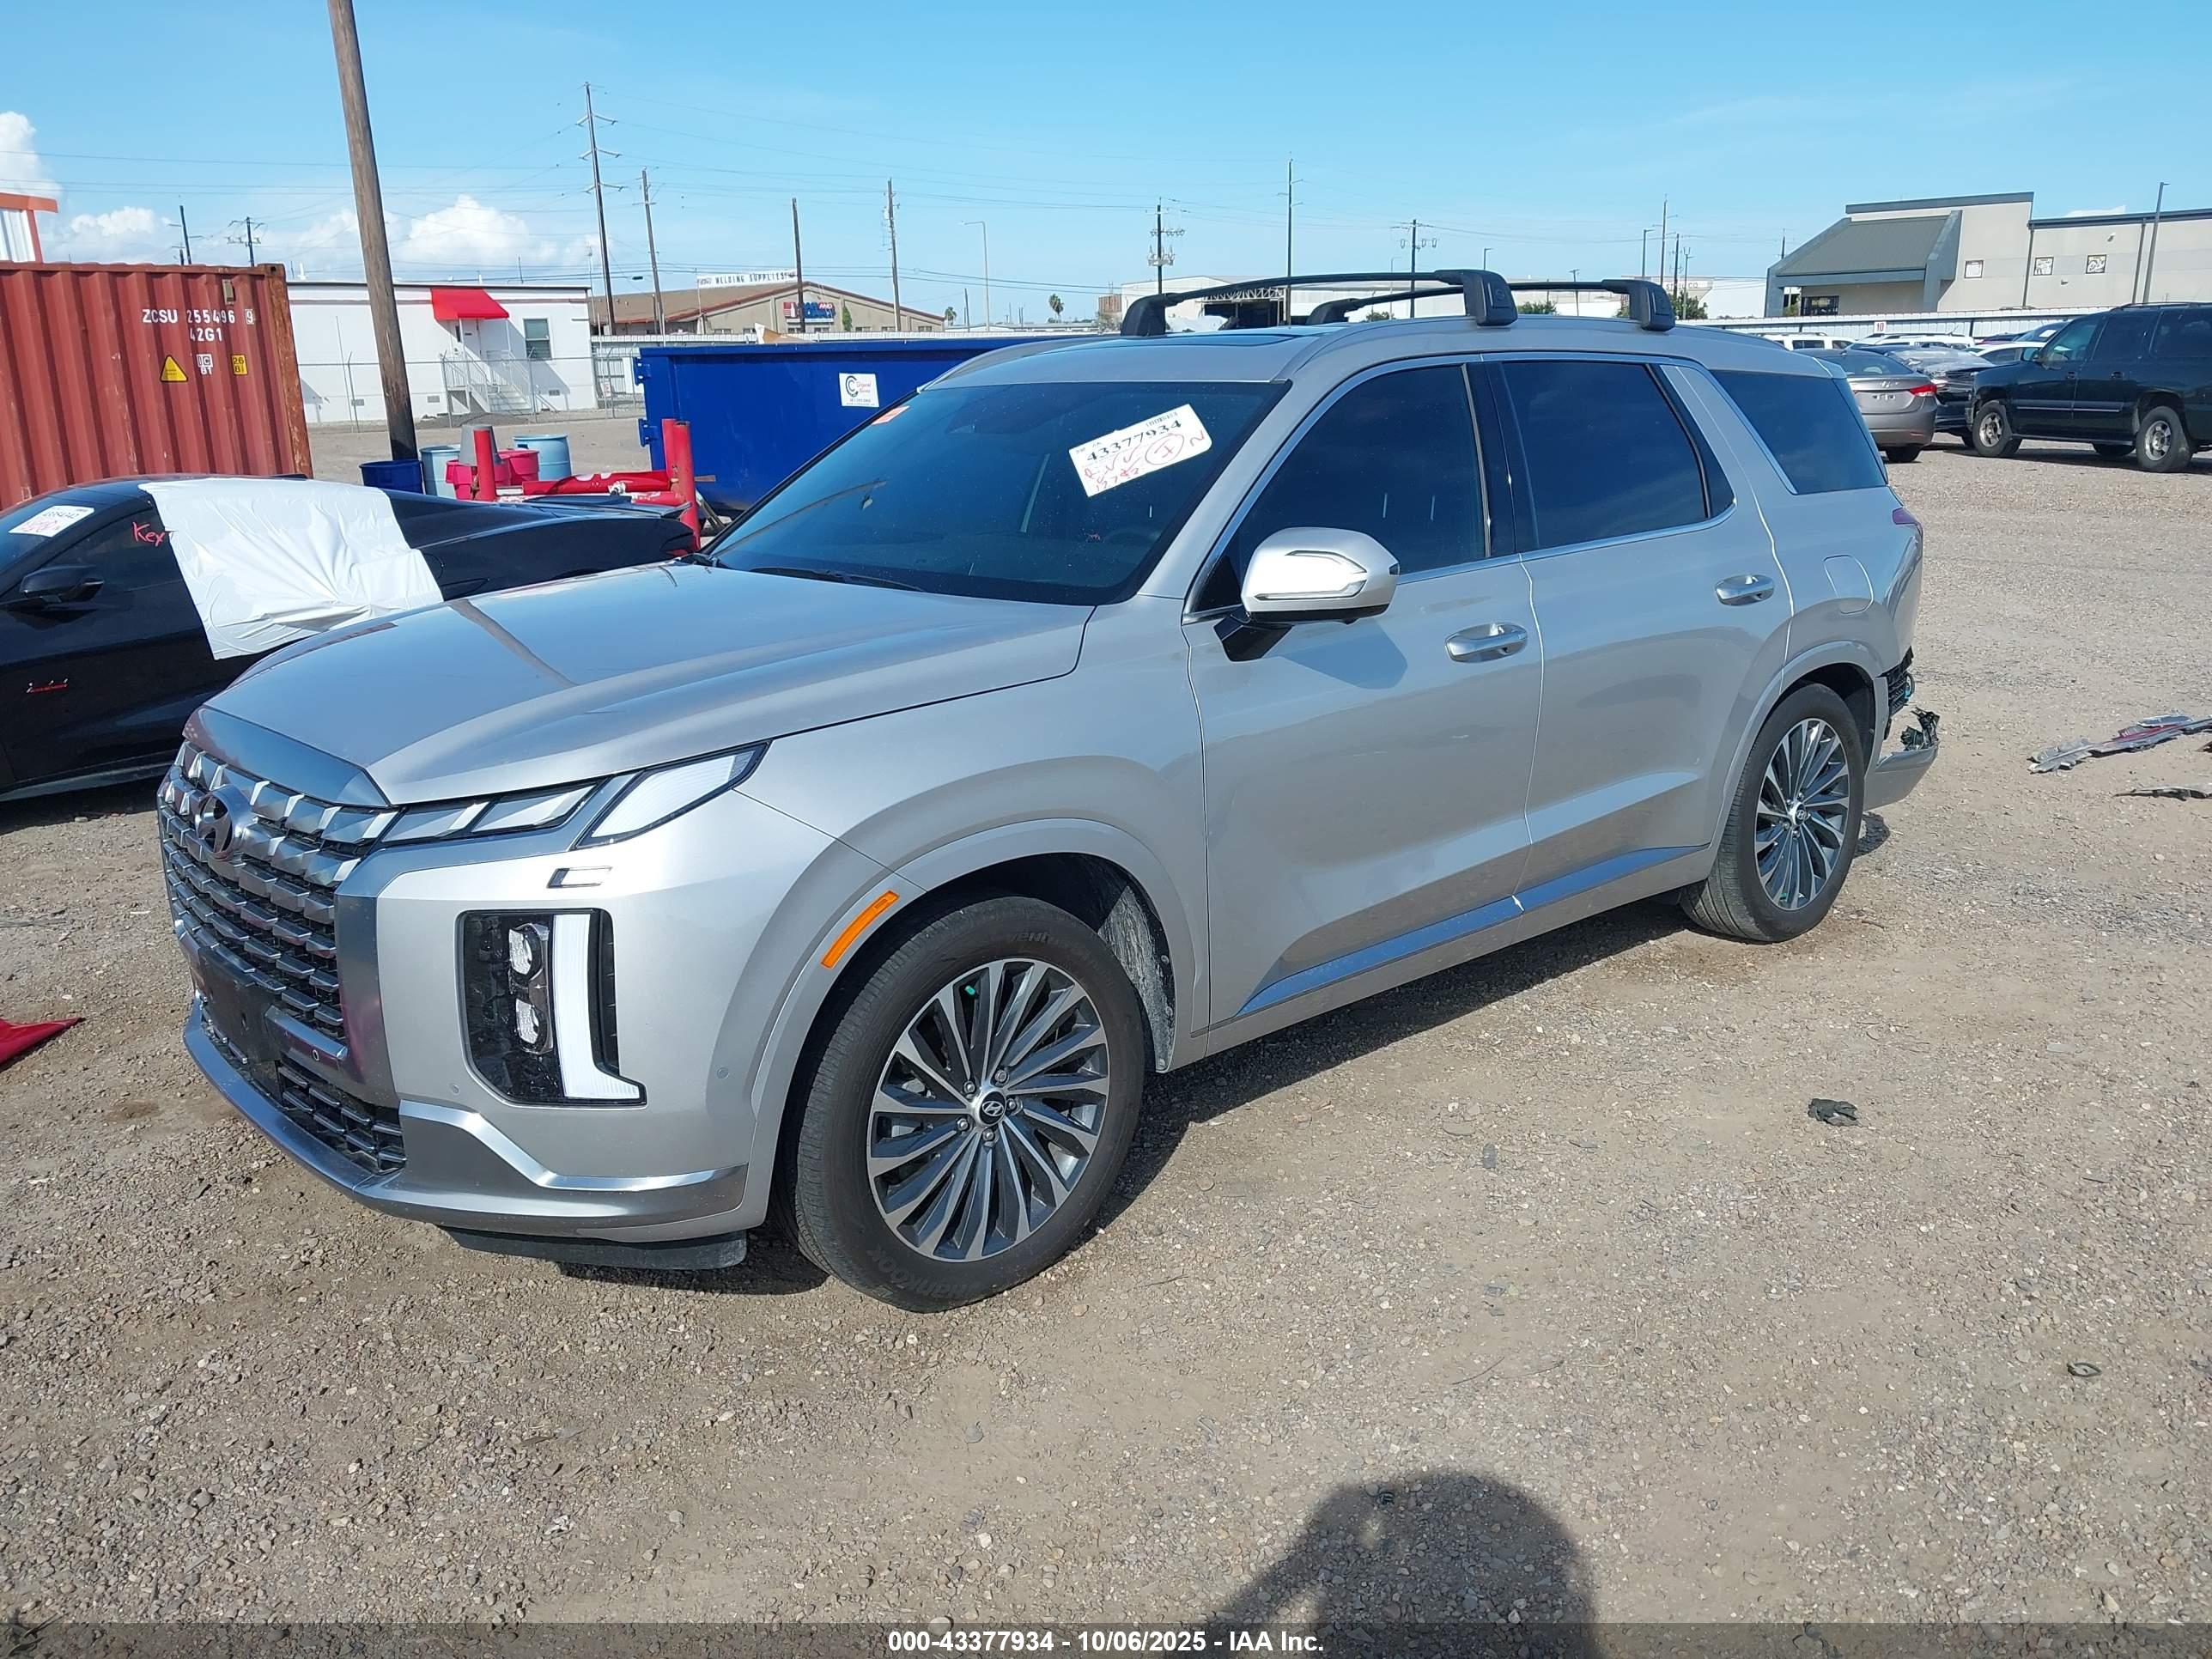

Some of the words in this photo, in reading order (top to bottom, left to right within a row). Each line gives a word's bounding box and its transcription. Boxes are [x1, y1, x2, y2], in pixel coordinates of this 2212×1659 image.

[143, 309, 178, 324] ZCSU
[186, 309, 235, 324] 255496
[246, 310, 253, 324] 9
[1876, 322, 1885, 331] 10
[190, 327, 222, 342] 42G1
[1087, 420, 1182, 462] 43377934
